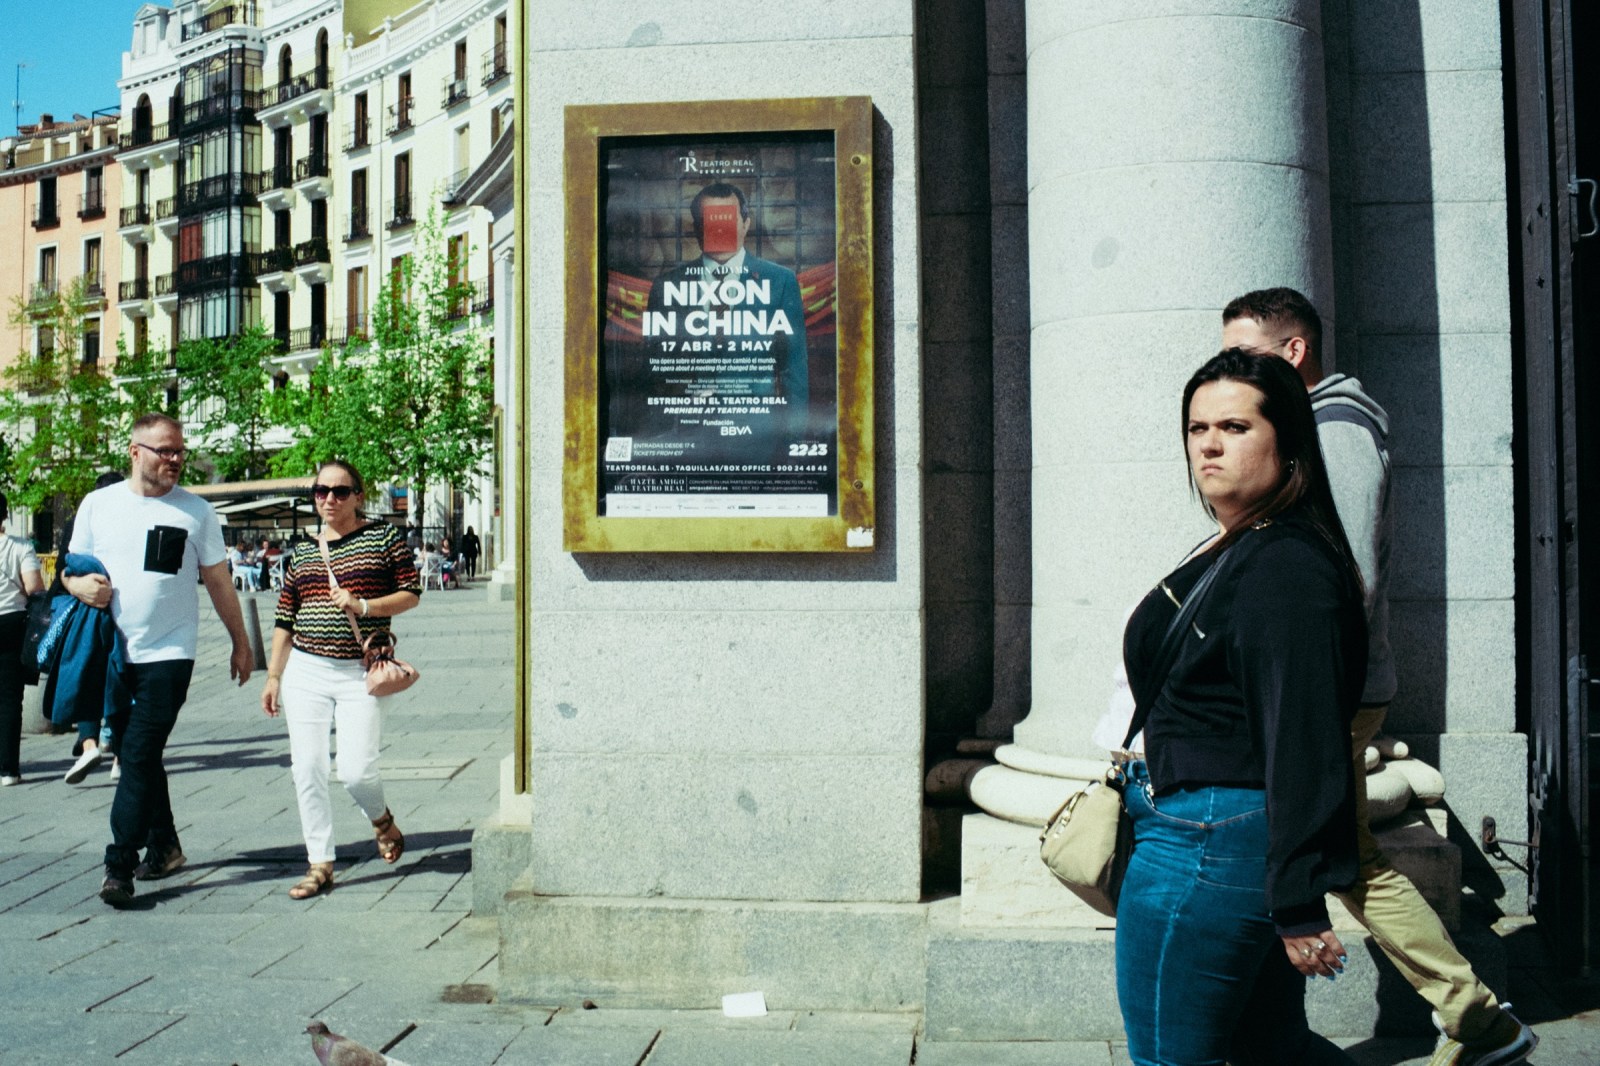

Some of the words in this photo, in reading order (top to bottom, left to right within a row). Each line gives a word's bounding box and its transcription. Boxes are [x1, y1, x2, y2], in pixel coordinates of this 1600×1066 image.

[685, 267, 710, 275] JOHN
[713, 266, 748, 275] ADAMS
[664, 279, 770, 306] NIXON
[642, 312, 677, 336] IN
[685, 310, 793, 336] CHINA
[662, 342, 676, 352] 17
[681, 341, 712, 351] ABR
[728, 341, 736, 351] 2
[742, 341, 772, 351] MAY
[721, 426, 752, 436] BBVA
